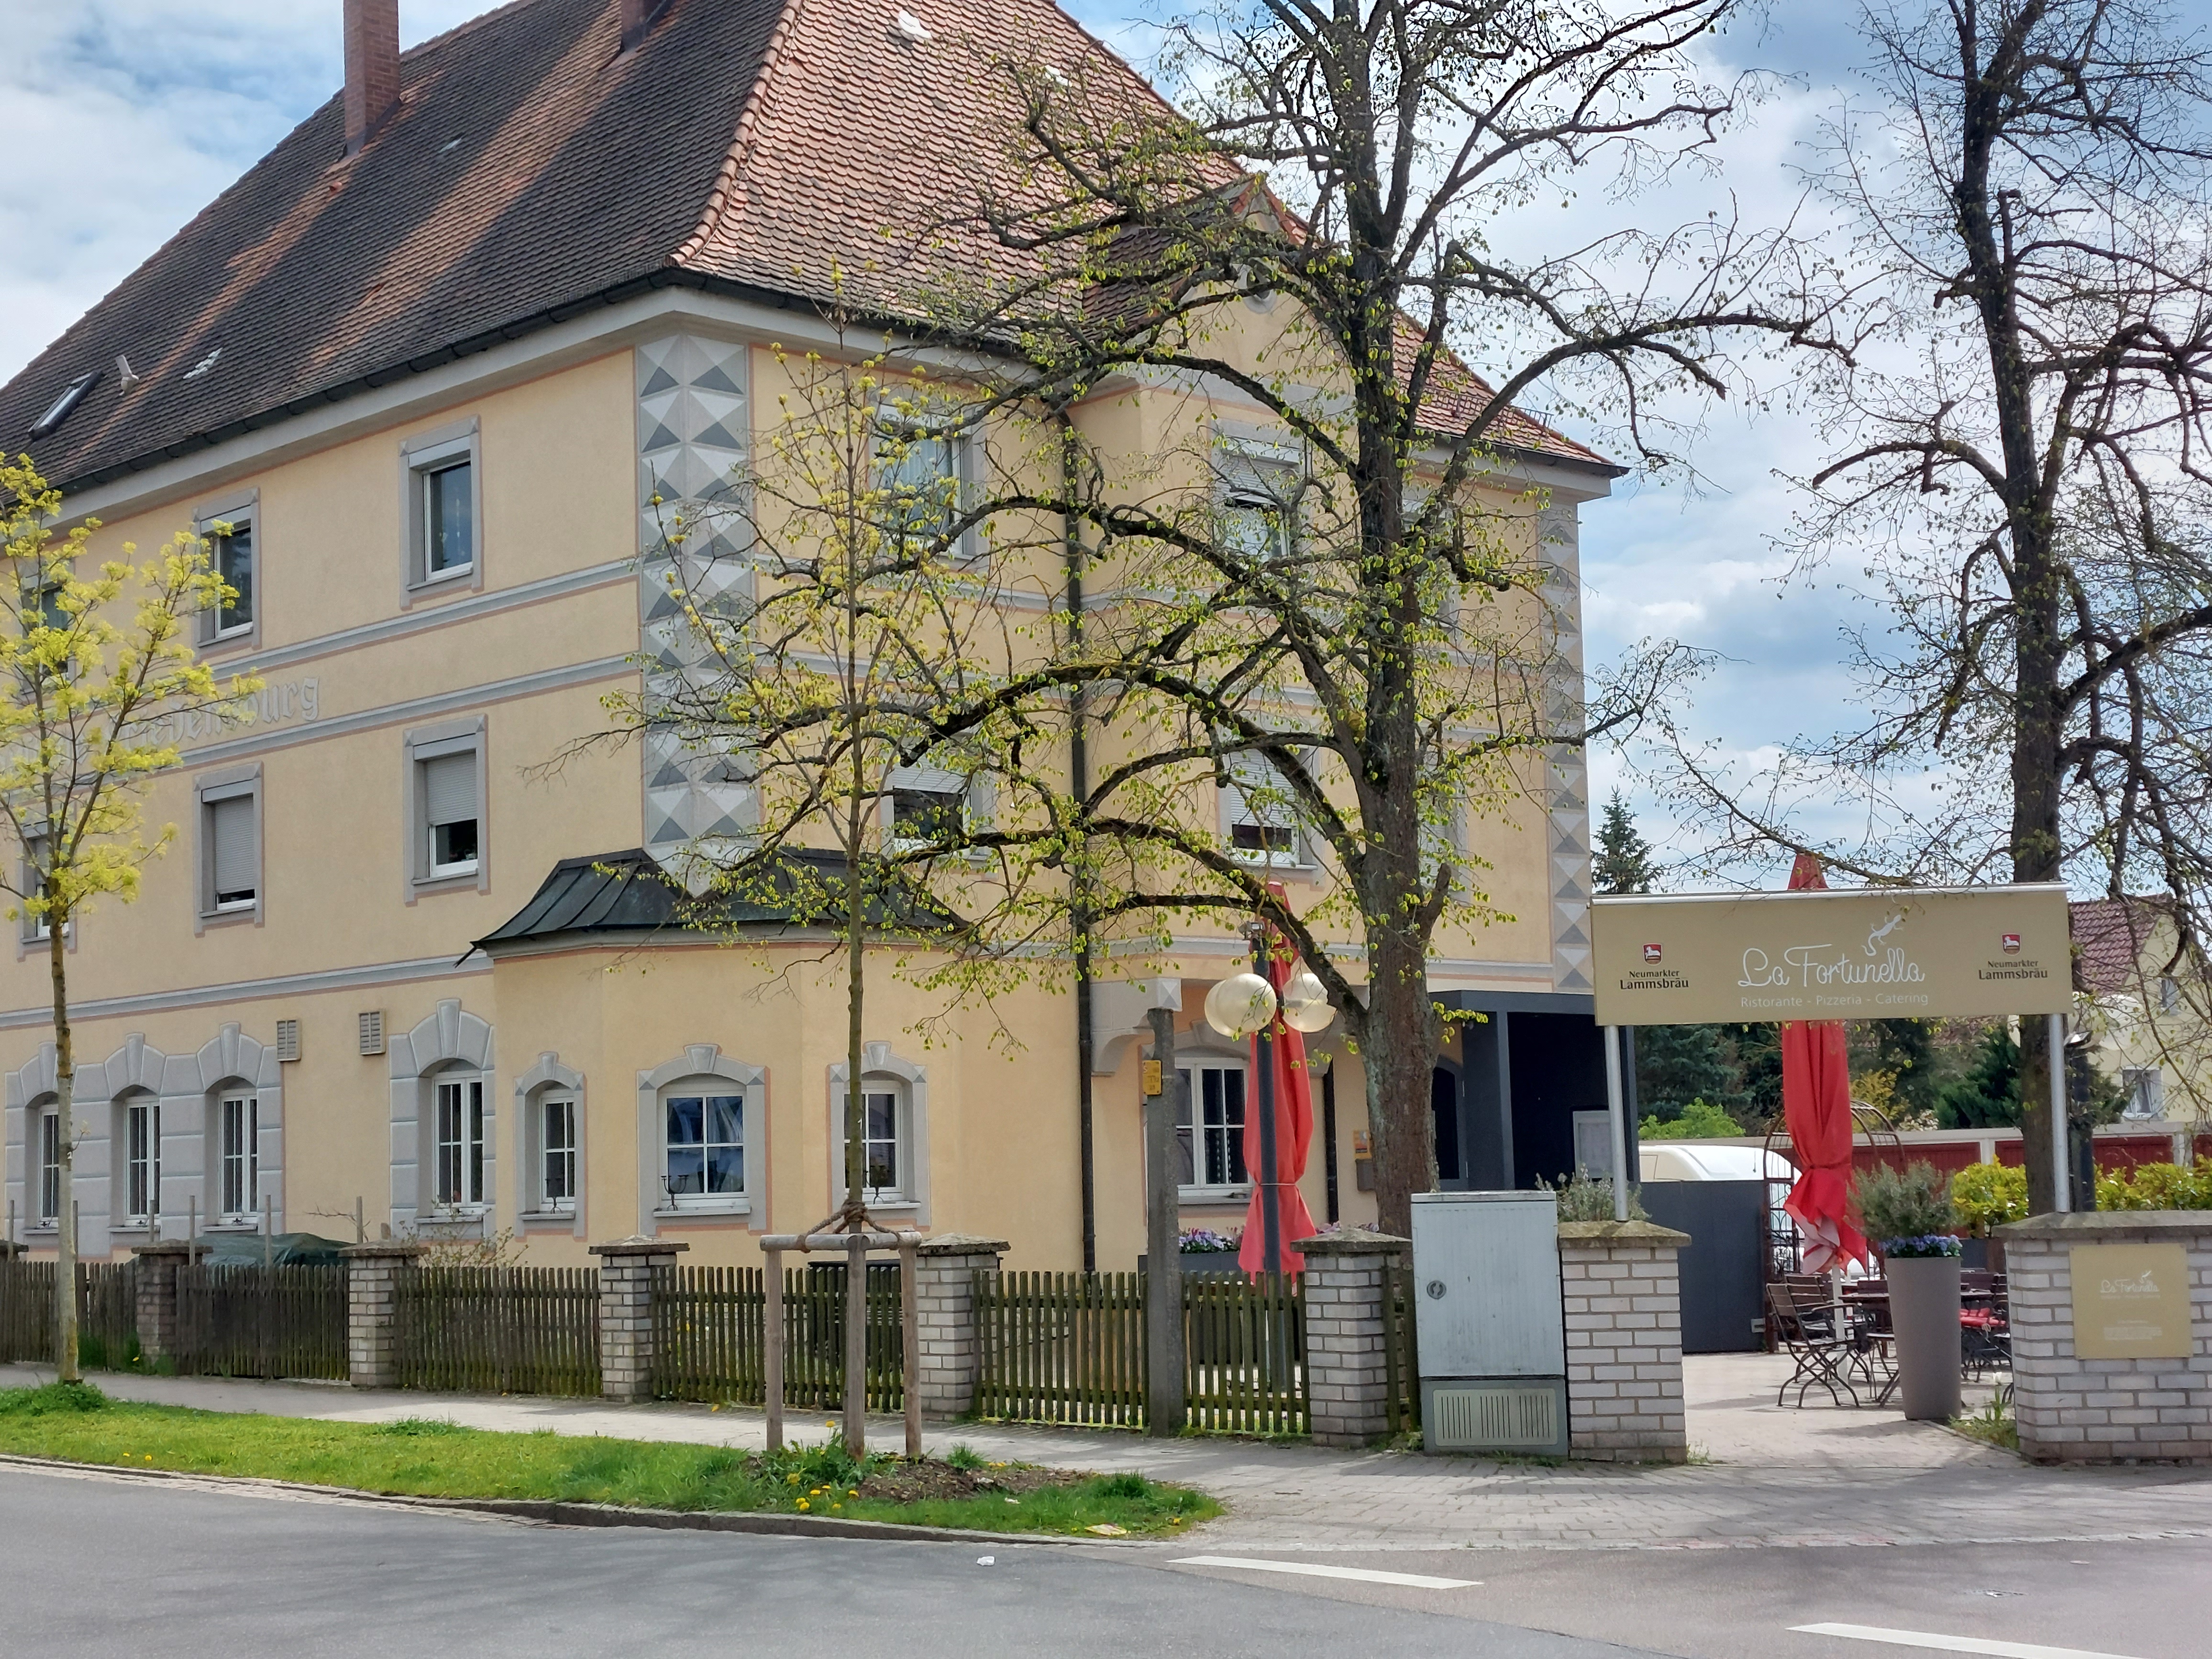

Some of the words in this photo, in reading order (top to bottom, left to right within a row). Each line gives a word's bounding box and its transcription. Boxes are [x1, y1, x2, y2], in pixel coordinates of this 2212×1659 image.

[1737, 948, 1790, 987] La
[1784, 943, 1925, 987] Fortunella
[1988, 960, 2038, 968] Neumarkter
[1629, 969, 1680, 978] Neumarkter
[1979, 968, 2048, 980] Lammsbräu
[1620, 978, 1689, 989] Lammsbräu
[1741, 996, 1803, 1007] Ristorante
[1816, 995, 1862, 1005] Pizzeria
[1875, 993, 1928, 1006] Catering
